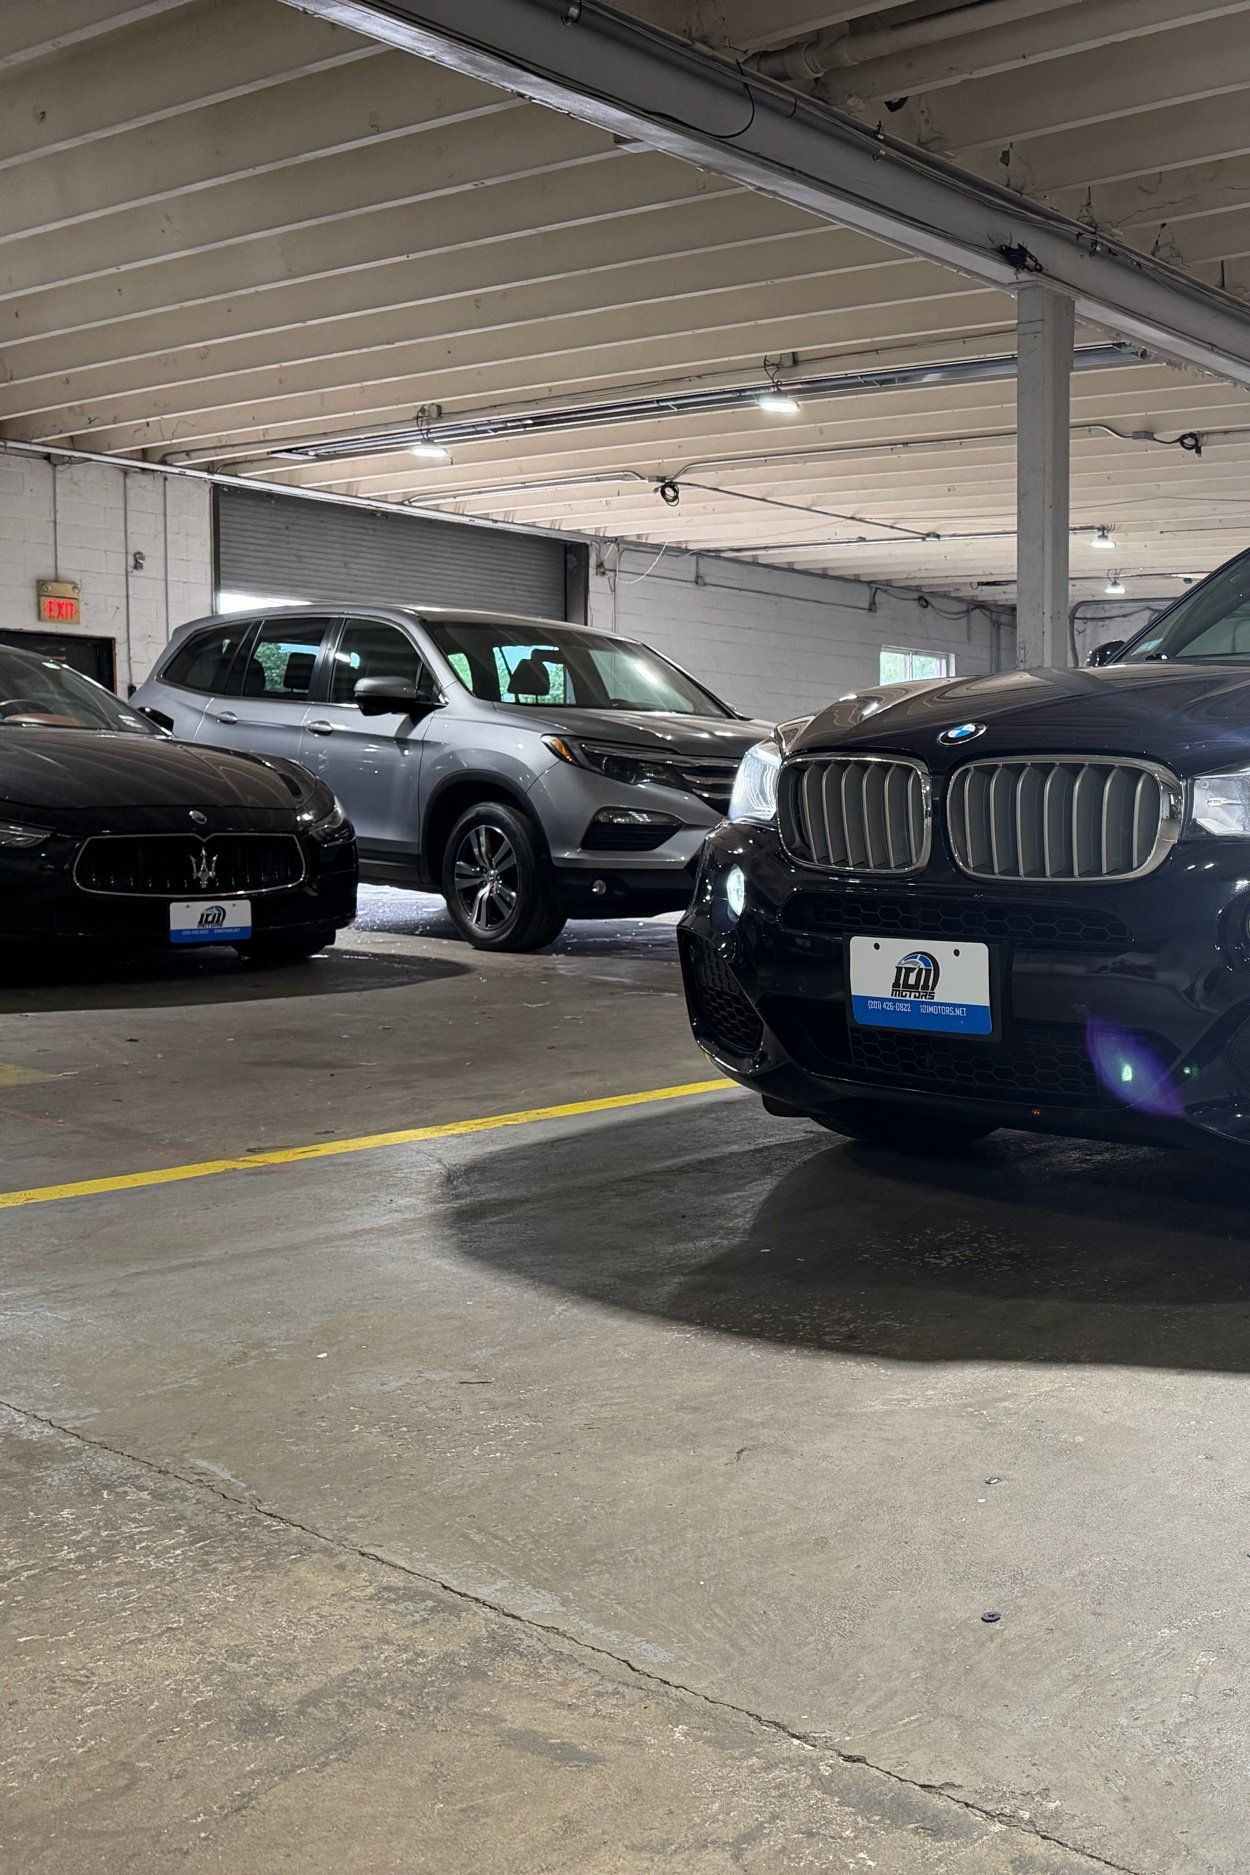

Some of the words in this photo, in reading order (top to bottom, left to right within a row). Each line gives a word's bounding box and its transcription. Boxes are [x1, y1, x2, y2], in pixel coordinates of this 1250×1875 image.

[47, 599, 74, 620] EXIT
[892, 966, 933, 991] 101
[891, 989, 935, 1001] MOTORS
[867, 1000, 881, 1010] (201)
[920, 1004, 967, 1017] 101MOTORS.NET
